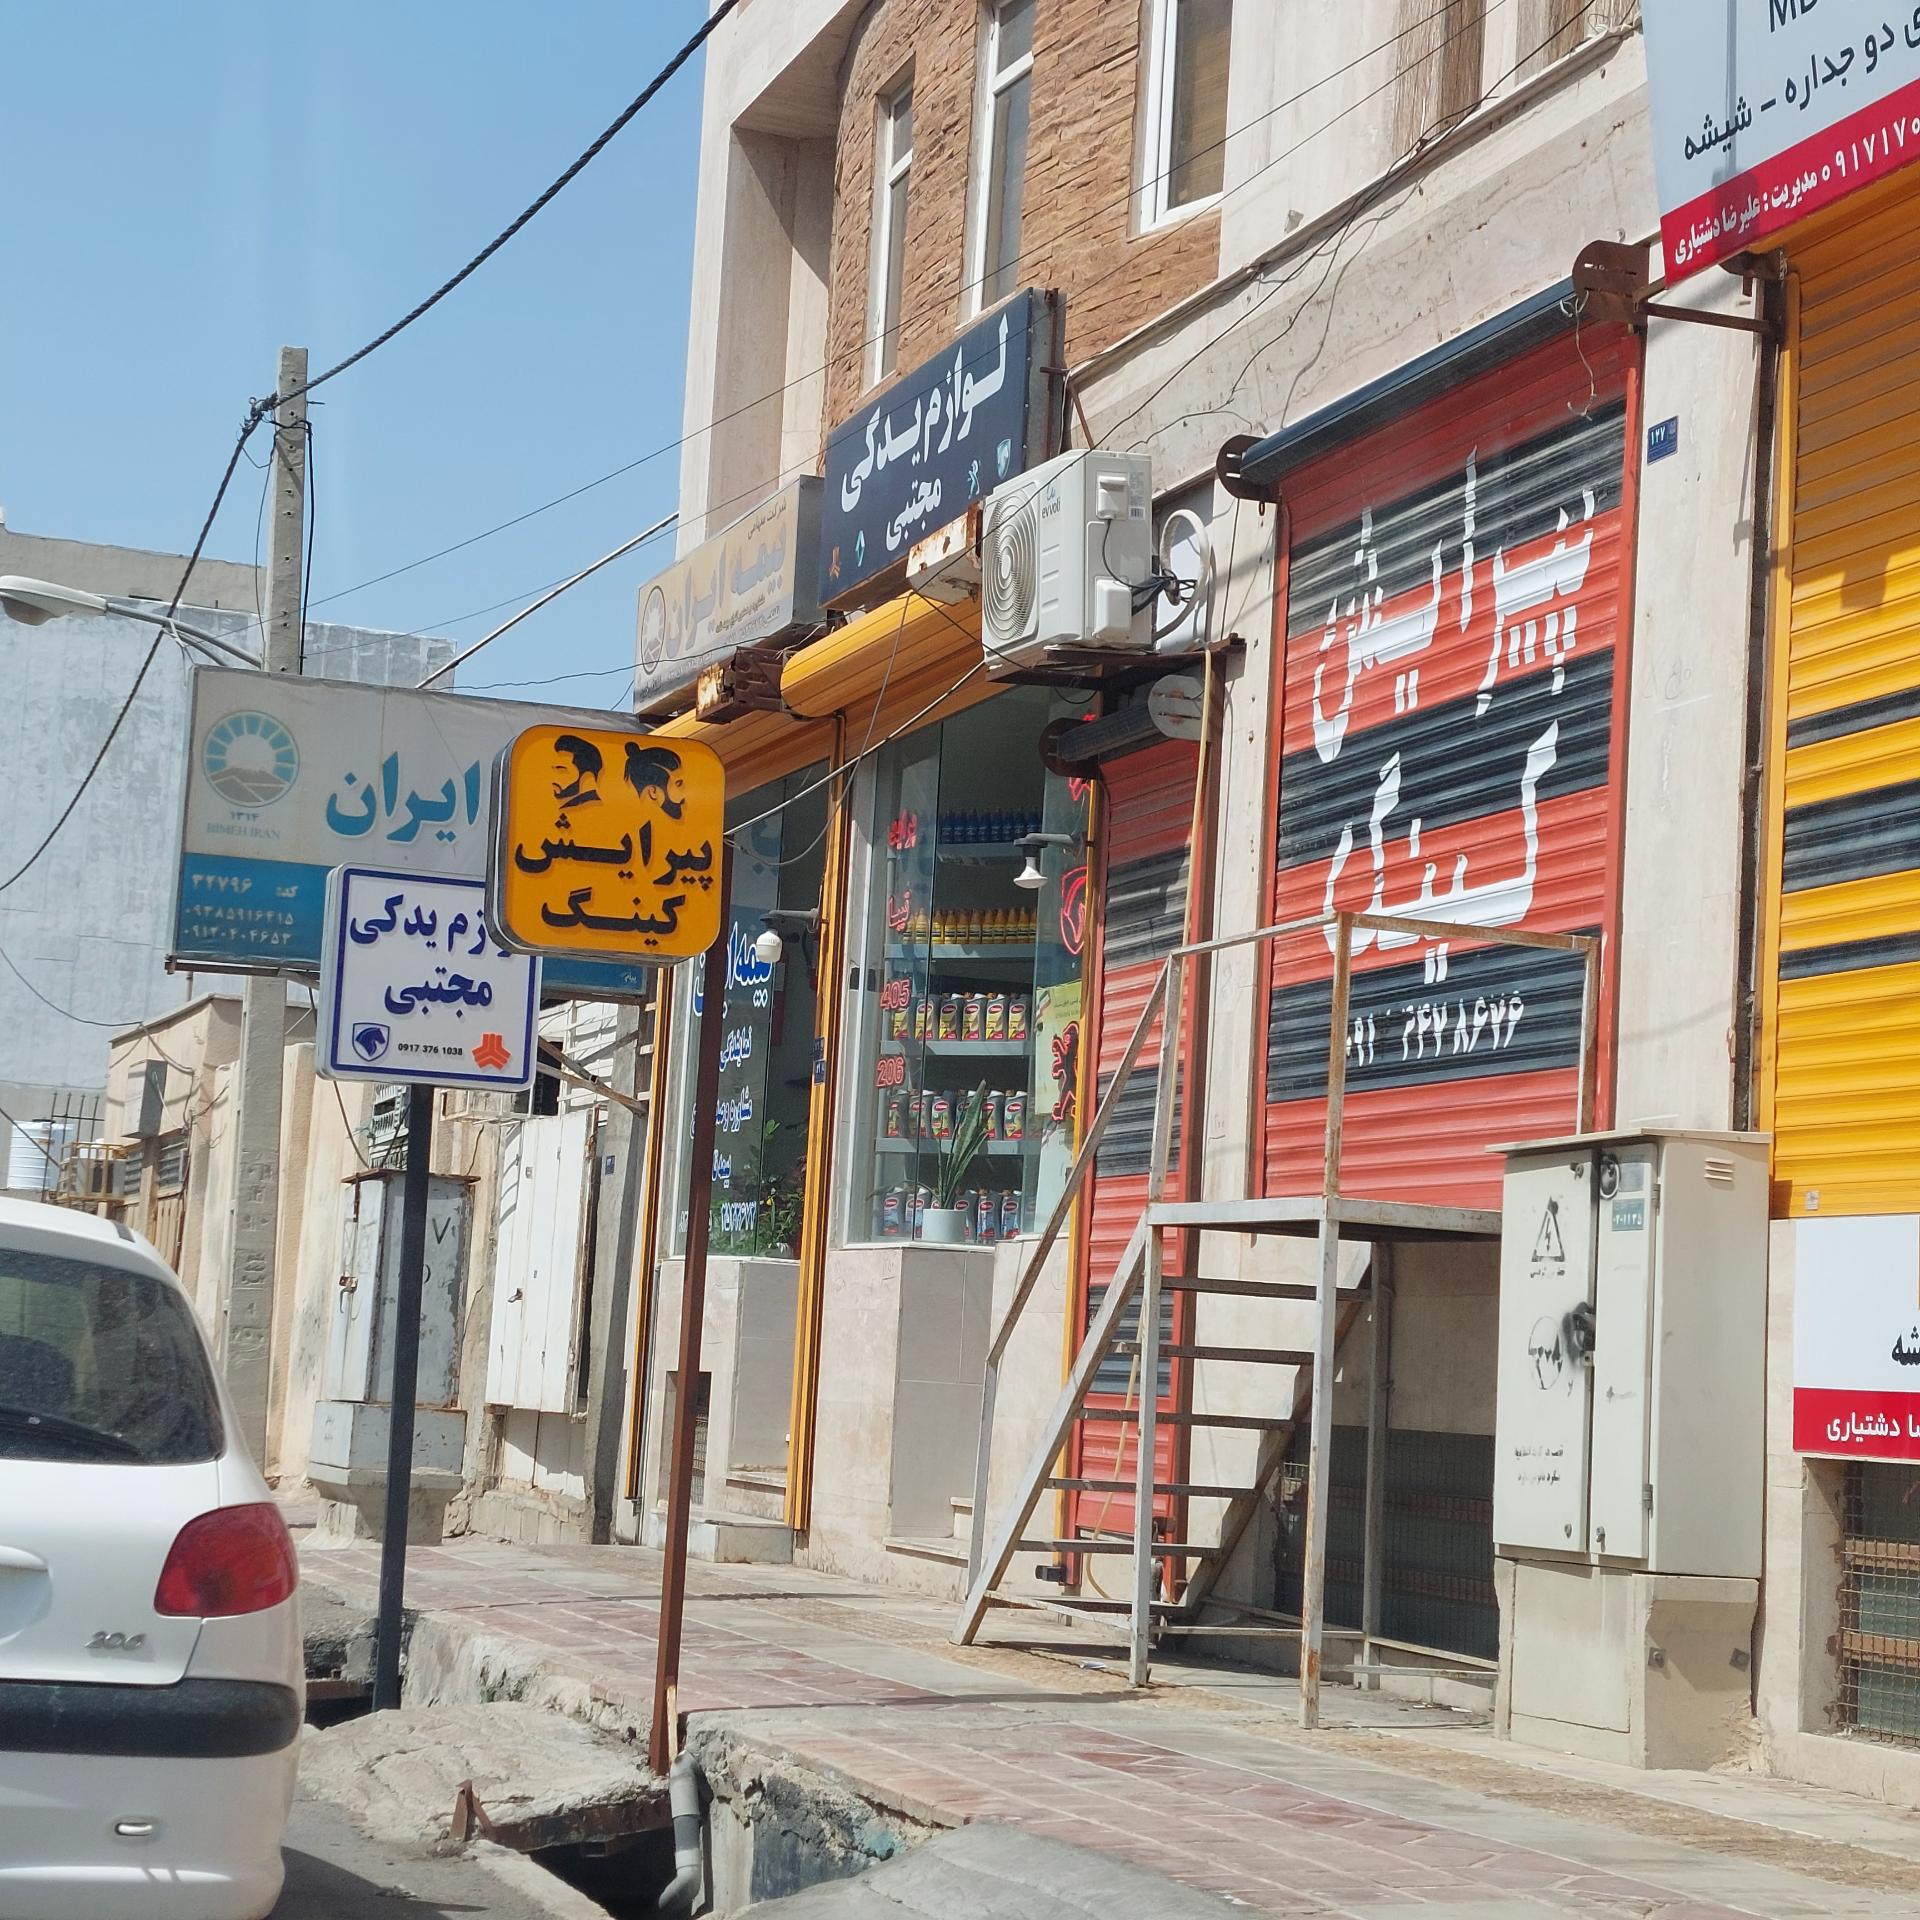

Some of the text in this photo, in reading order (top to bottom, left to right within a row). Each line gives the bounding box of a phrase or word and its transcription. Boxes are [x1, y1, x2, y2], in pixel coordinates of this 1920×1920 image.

[1785, 46, 1856, 111] جداره
[1684, 96, 1753, 160] شیشه
[1674, 216, 1721, 265] دشتیاری
[1722, 194, 1761, 235] علیرضا
[841, 311, 1009, 513] لوازم یدکی
[886, 477, 942, 552] مجتبی
[1041, 498, 1062, 520] evvoli
[665, 537, 728, 660] ایران
[1312, 444, 1596, 764] پیرایش
[325, 751, 481, 844] ایران
[206, 822, 281, 840] BIMEH IRAN
[514, 812, 713, 892] پیرایش
[1321, 718, 1560, 985] کینگ
[349, 893, 438, 949] یدکی
[541, 886, 687, 947] کینگ
[384, 966, 493, 1019] مجتبی
[880, 977, 911, 1011] 405
[397, 1042, 463, 1056] 0917 376 1038
[875, 1055, 905, 1089] 206
[1826, 1411, 1901, 1443] دشتیاری
[84, 1631, 148, 1650] 206
